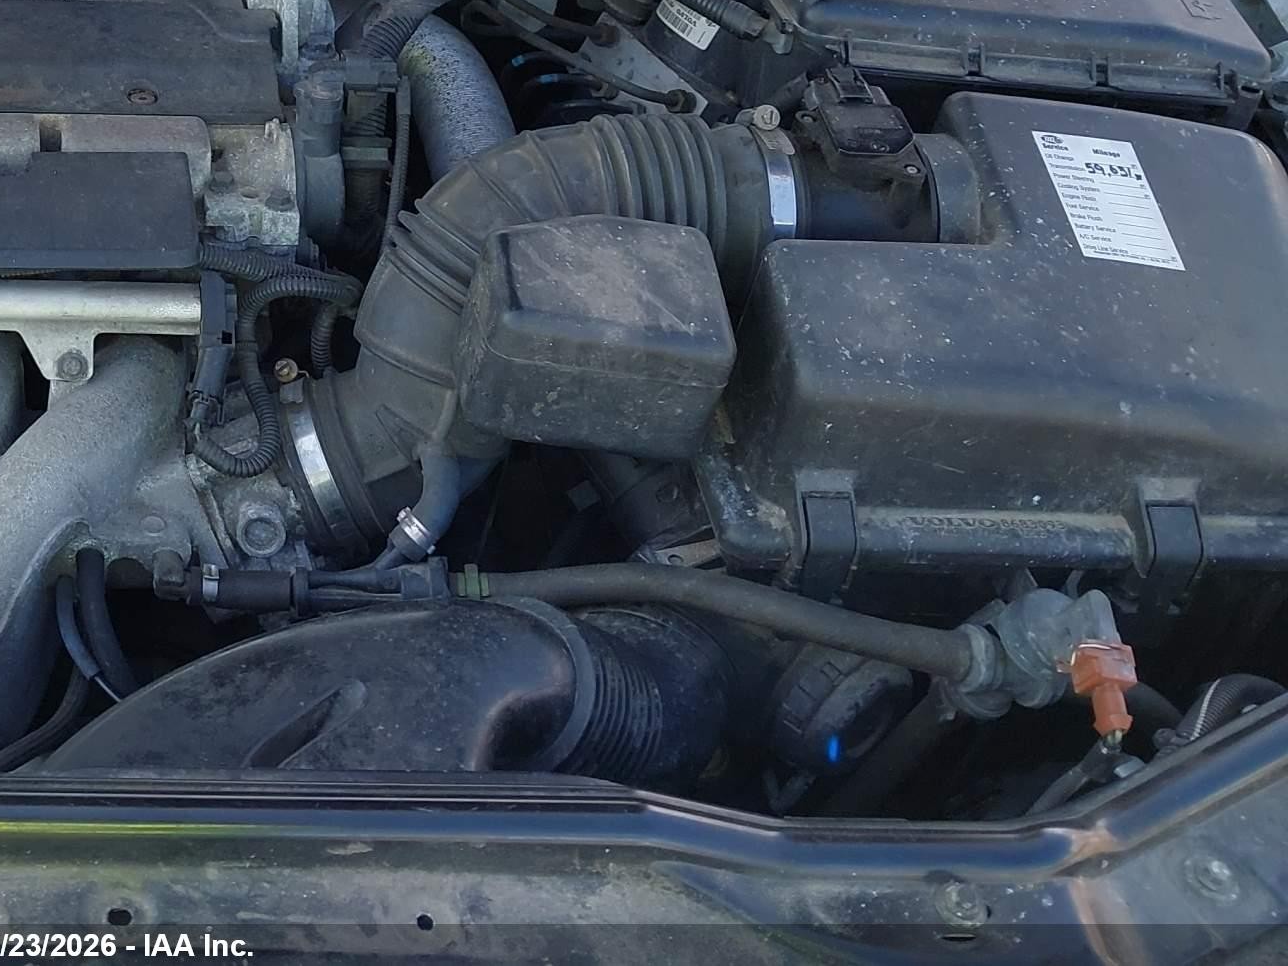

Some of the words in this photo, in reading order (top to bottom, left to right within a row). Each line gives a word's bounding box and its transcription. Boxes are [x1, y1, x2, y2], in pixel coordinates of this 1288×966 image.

[676, 9, 697, 27] VOLVO
[1092, 148, 1121, 158] Mileage
[905, 516, 997, 528] VOLVO
